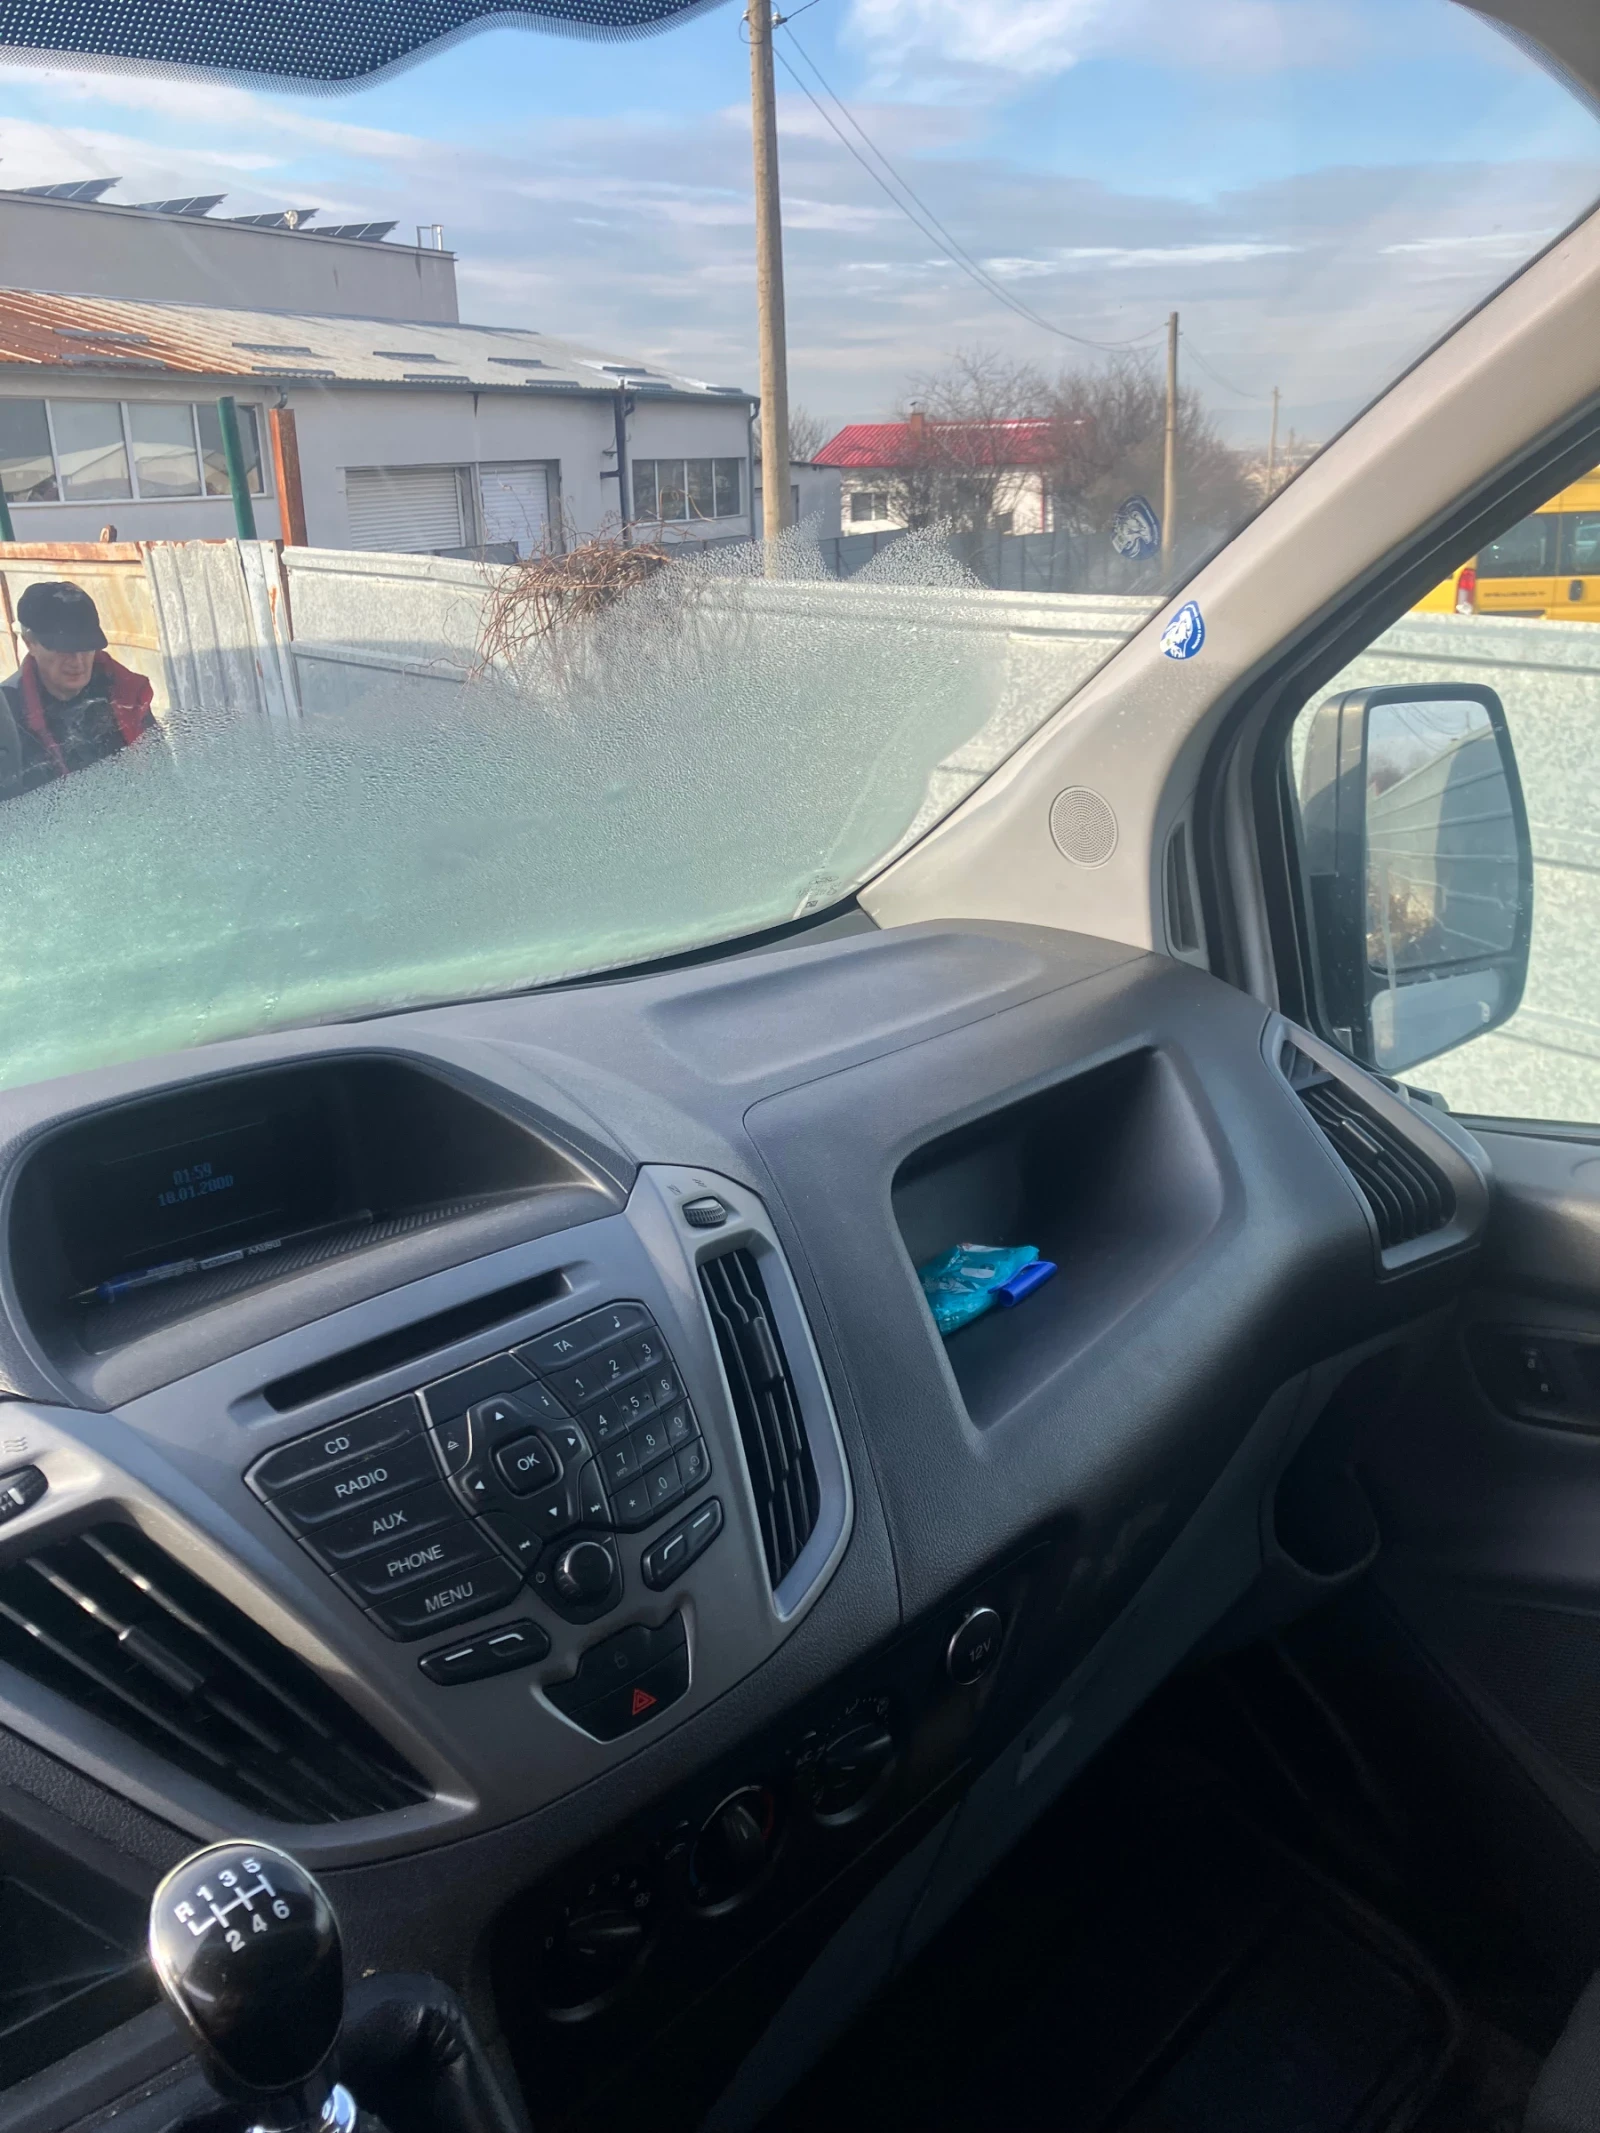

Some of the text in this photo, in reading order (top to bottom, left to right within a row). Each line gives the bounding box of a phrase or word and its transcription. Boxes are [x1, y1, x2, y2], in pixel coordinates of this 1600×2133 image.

[173, 1162, 212, 1186] 01:59
[157, 1174, 234, 1207] 18.01.2000
[553, 1339, 574, 1353] TA
[575, 1343, 652, 1389] 1 2 3
[599, 1379, 670, 1425] 4 5 6
[324, 1436, 350, 1454] CD
[616, 1417, 683, 1464] 7 8 9
[517, 1453, 541, 1471] OK
[334, 1468, 388, 1498] RADIO
[658, 1476, 668, 1489] 0
[372, 1510, 408, 1535] AUX
[386, 1544, 445, 1577] PHONE
[424, 1581, 474, 1613] MENU
[969, 1637, 991, 1662] 12V
[174, 1858, 261, 1923] R 1 3 5
[225, 1900, 290, 1953] 2 4 6
